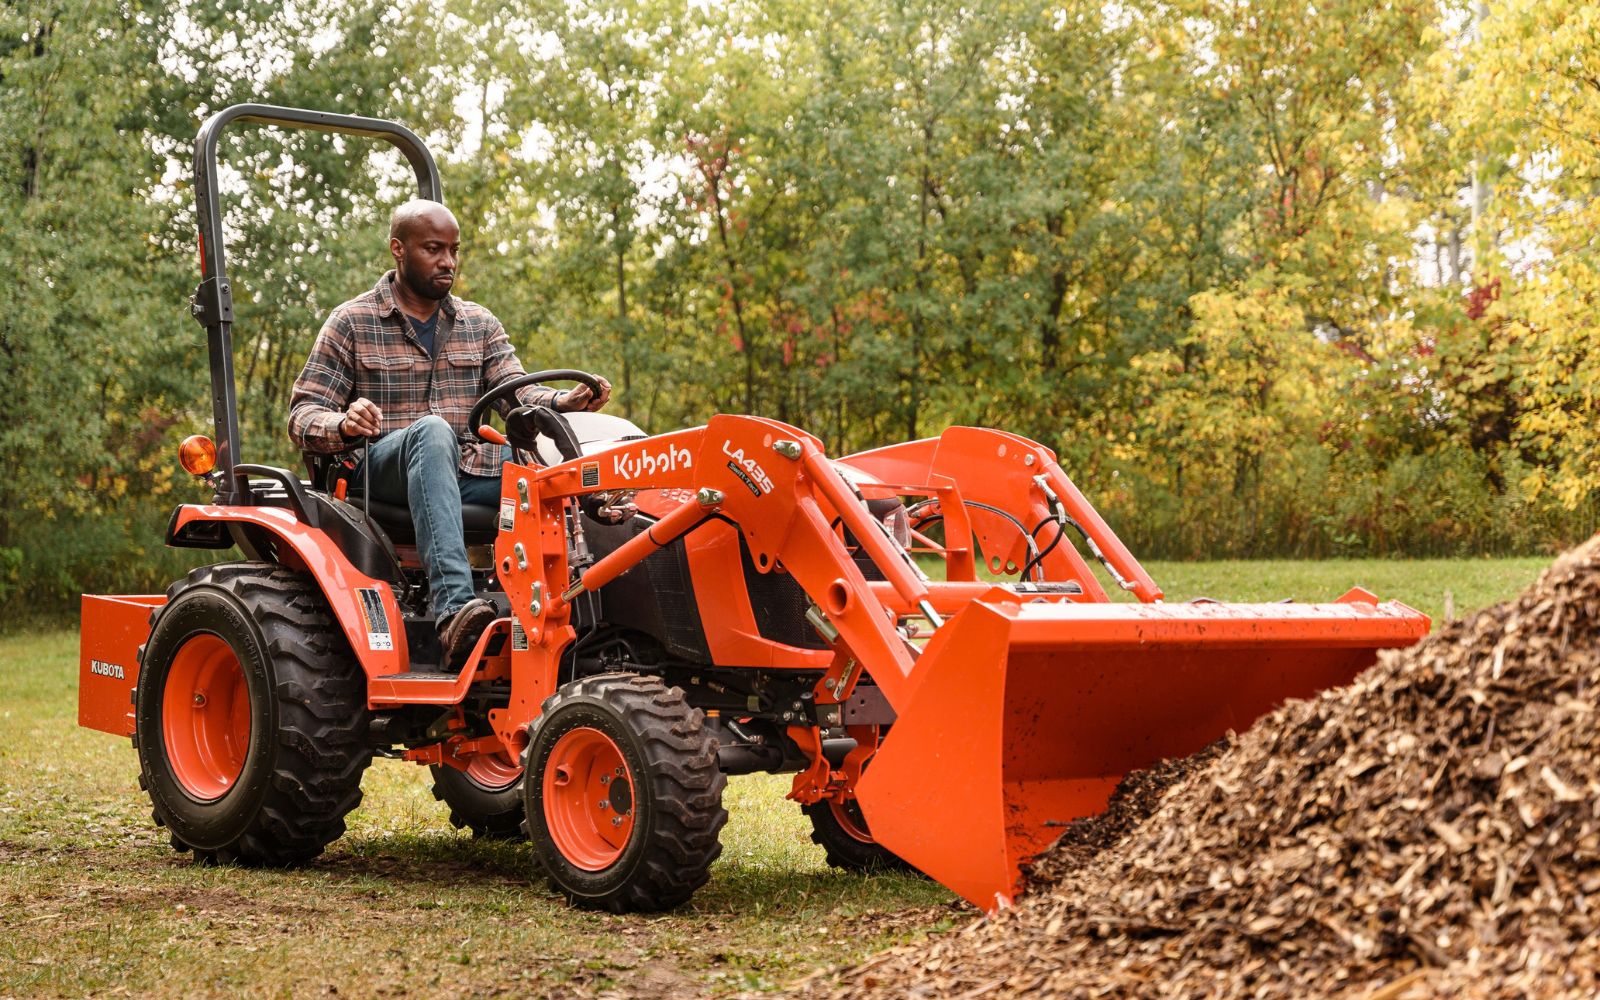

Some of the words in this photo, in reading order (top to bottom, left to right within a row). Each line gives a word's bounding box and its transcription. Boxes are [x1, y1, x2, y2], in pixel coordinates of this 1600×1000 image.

[613, 443, 692, 480] Kubota
[722, 439, 775, 494] LA435
[91, 659, 125, 680] KUBOTA
